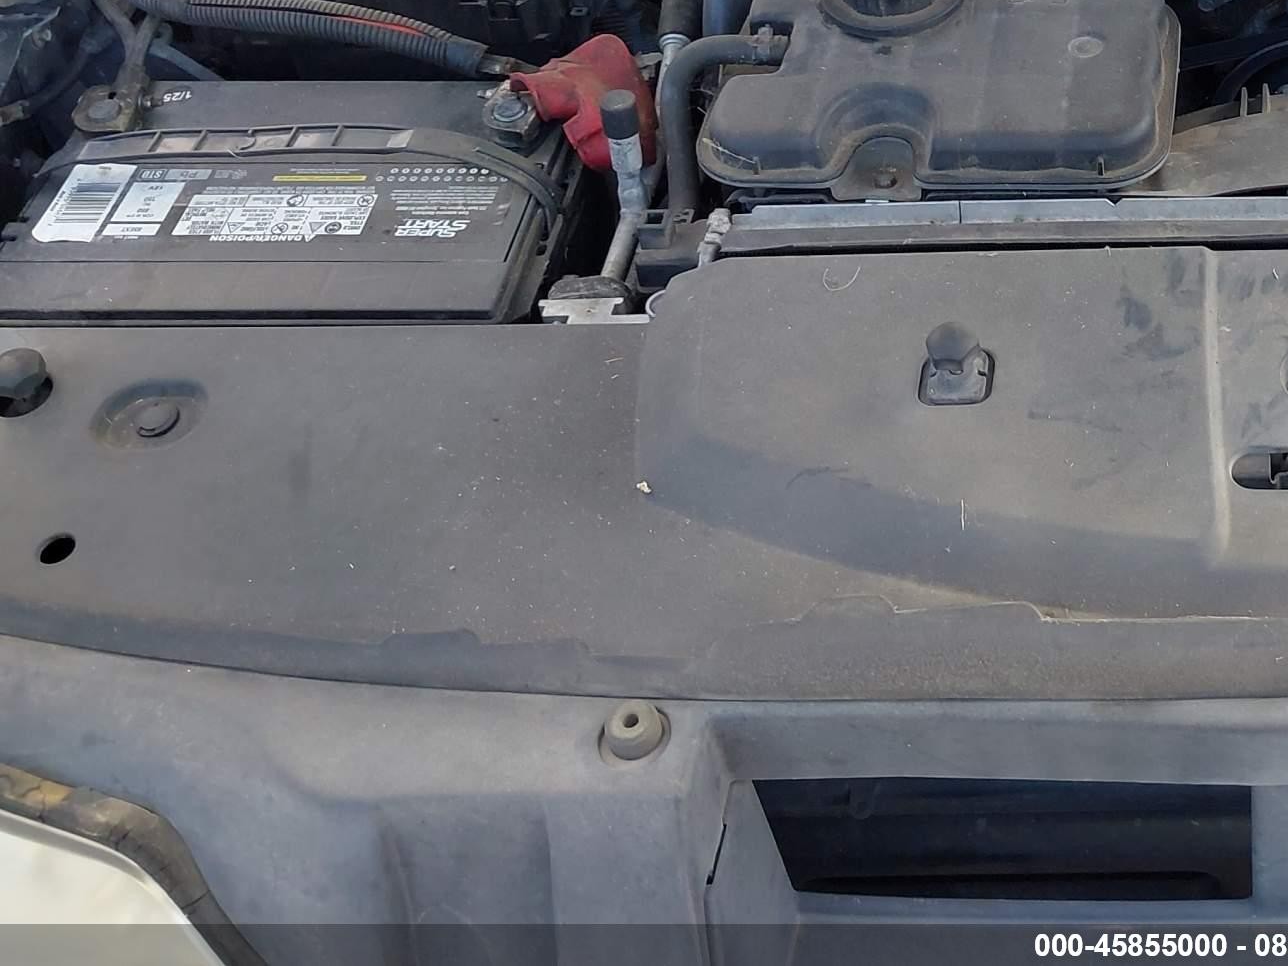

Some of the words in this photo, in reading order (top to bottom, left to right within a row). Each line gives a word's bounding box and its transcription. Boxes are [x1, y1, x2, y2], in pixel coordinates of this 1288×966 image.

[163, 90, 192, 103] 1/25
[397, 220, 471, 231] START
[208, 234, 303, 242] DANGER/POISON
[394, 228, 457, 238] SUPER
